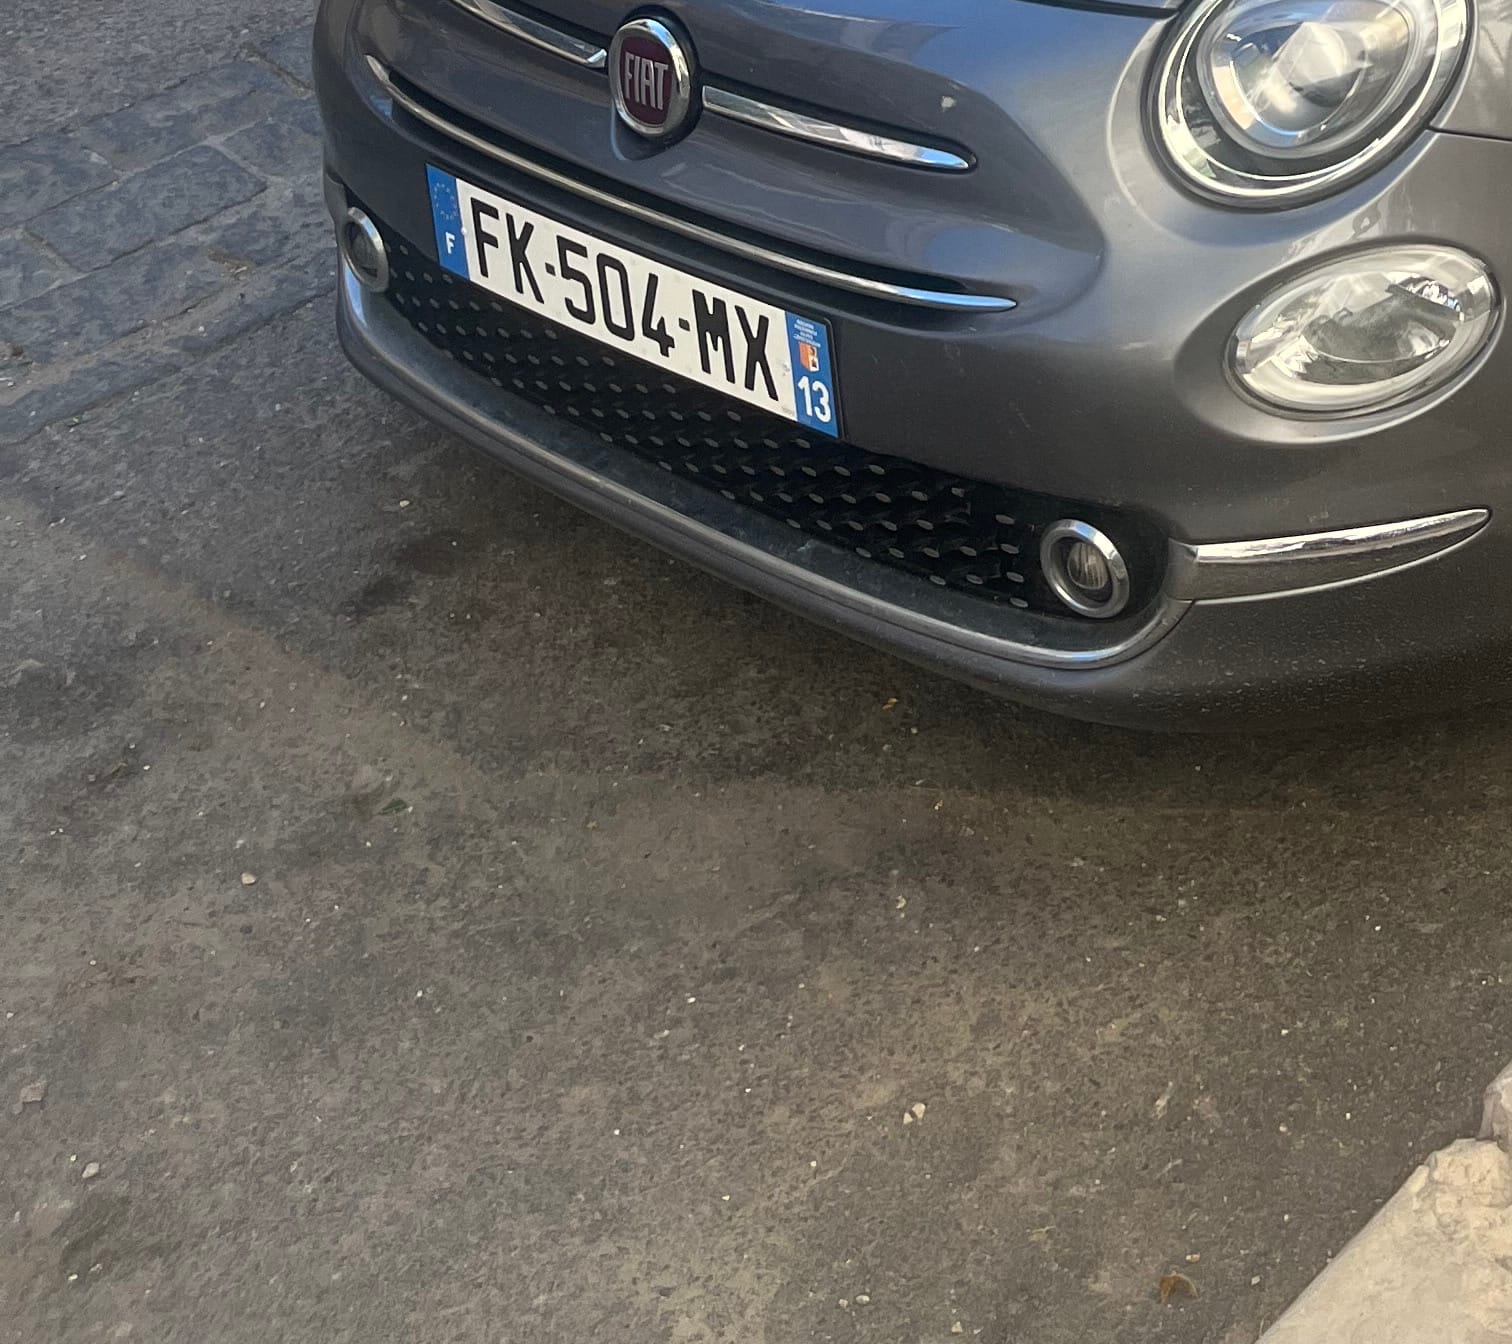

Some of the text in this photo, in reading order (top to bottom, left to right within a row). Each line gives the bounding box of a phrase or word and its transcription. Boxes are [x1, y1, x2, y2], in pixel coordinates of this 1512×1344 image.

[625, 52, 669, 110] FIAT
[445, 231, 456, 255] F
[470, 196, 779, 402] FK-504-MX
[798, 376, 832, 424] 13
